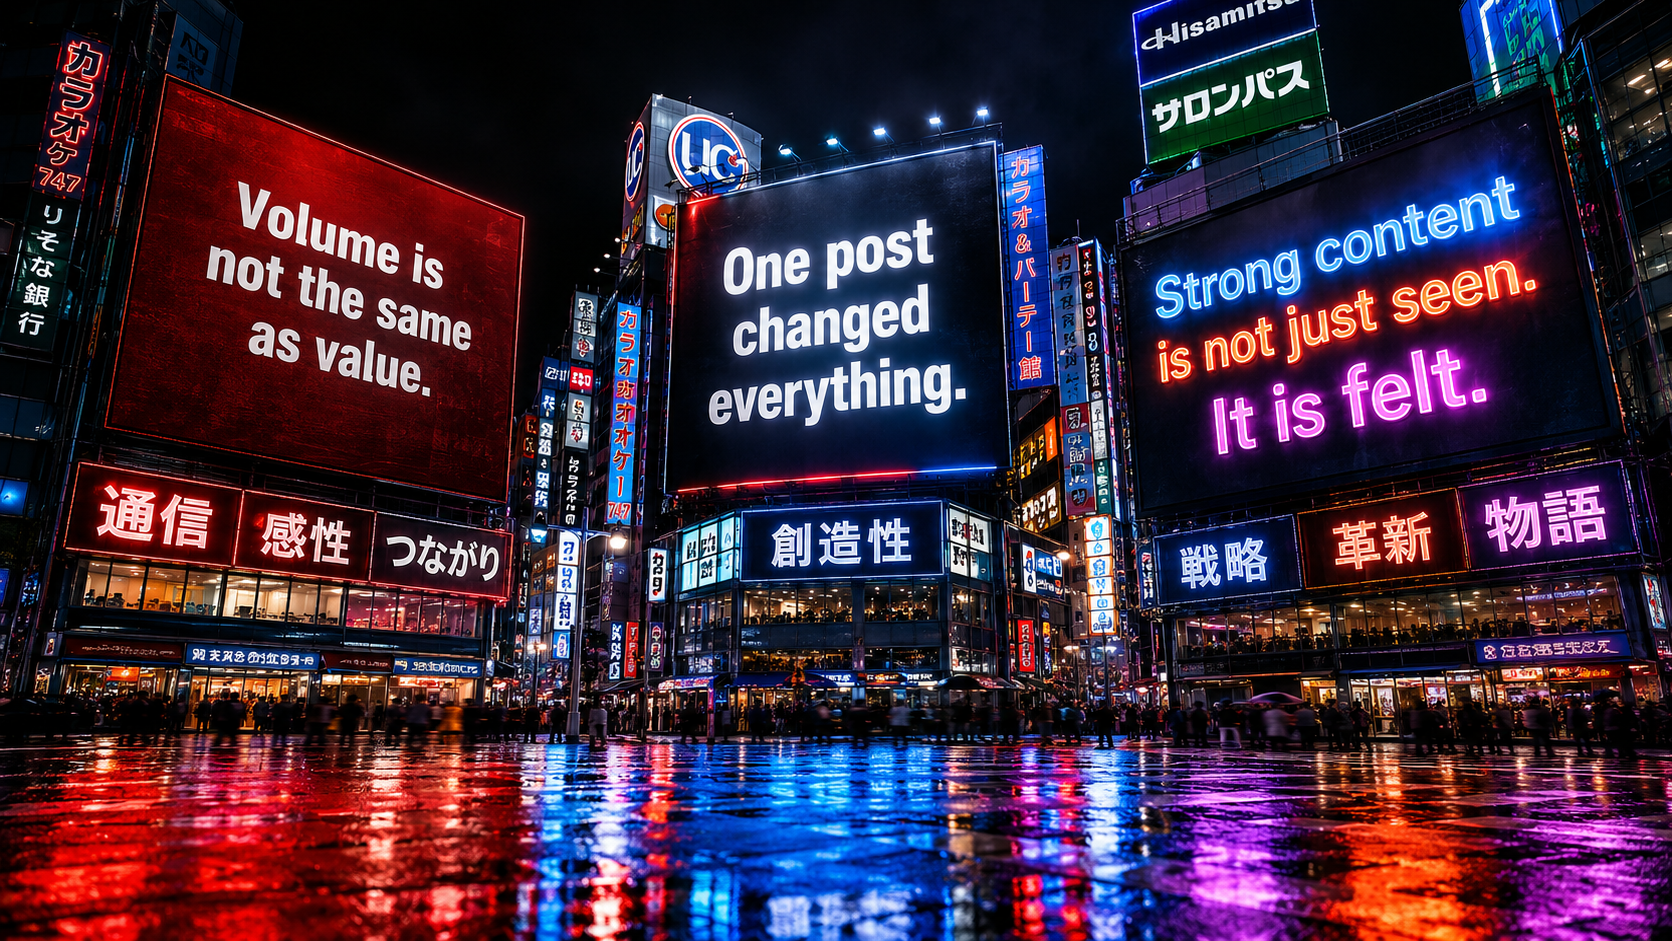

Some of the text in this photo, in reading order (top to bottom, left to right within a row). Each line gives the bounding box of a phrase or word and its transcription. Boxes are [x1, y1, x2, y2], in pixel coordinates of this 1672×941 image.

[1141, 0, 1301, 50] Hisamits
[47, 41, 102, 165] カラオケ
[1152, 60, 1310, 133] サロンパス
[38, 166, 82, 193] 747
[18, 204, 63, 337] りそな銀行
[238, 181, 444, 290] Volume is
[723, 218, 934, 295] One post
[1155, 175, 1520, 319] Strong content
[206, 245, 472, 351] not the same
[732, 283, 930, 356] changed
[1157, 259, 1538, 383] is not just seen.
[248, 321, 431, 397] as value.
[708, 357, 967, 426] everything.
[1213, 348, 1487, 455] It is felt.
[97, 484, 213, 550] 通信
[260, 511, 351, 566] 感性
[608, 501, 632, 520] 747
[771, 517, 912, 569] 創造性
[1332, 511, 1432, 571] 革新
[1485, 485, 1607, 553] 物語
[386, 532, 500, 582] つながり
[1180, 537, 1268, 590] 戦略
